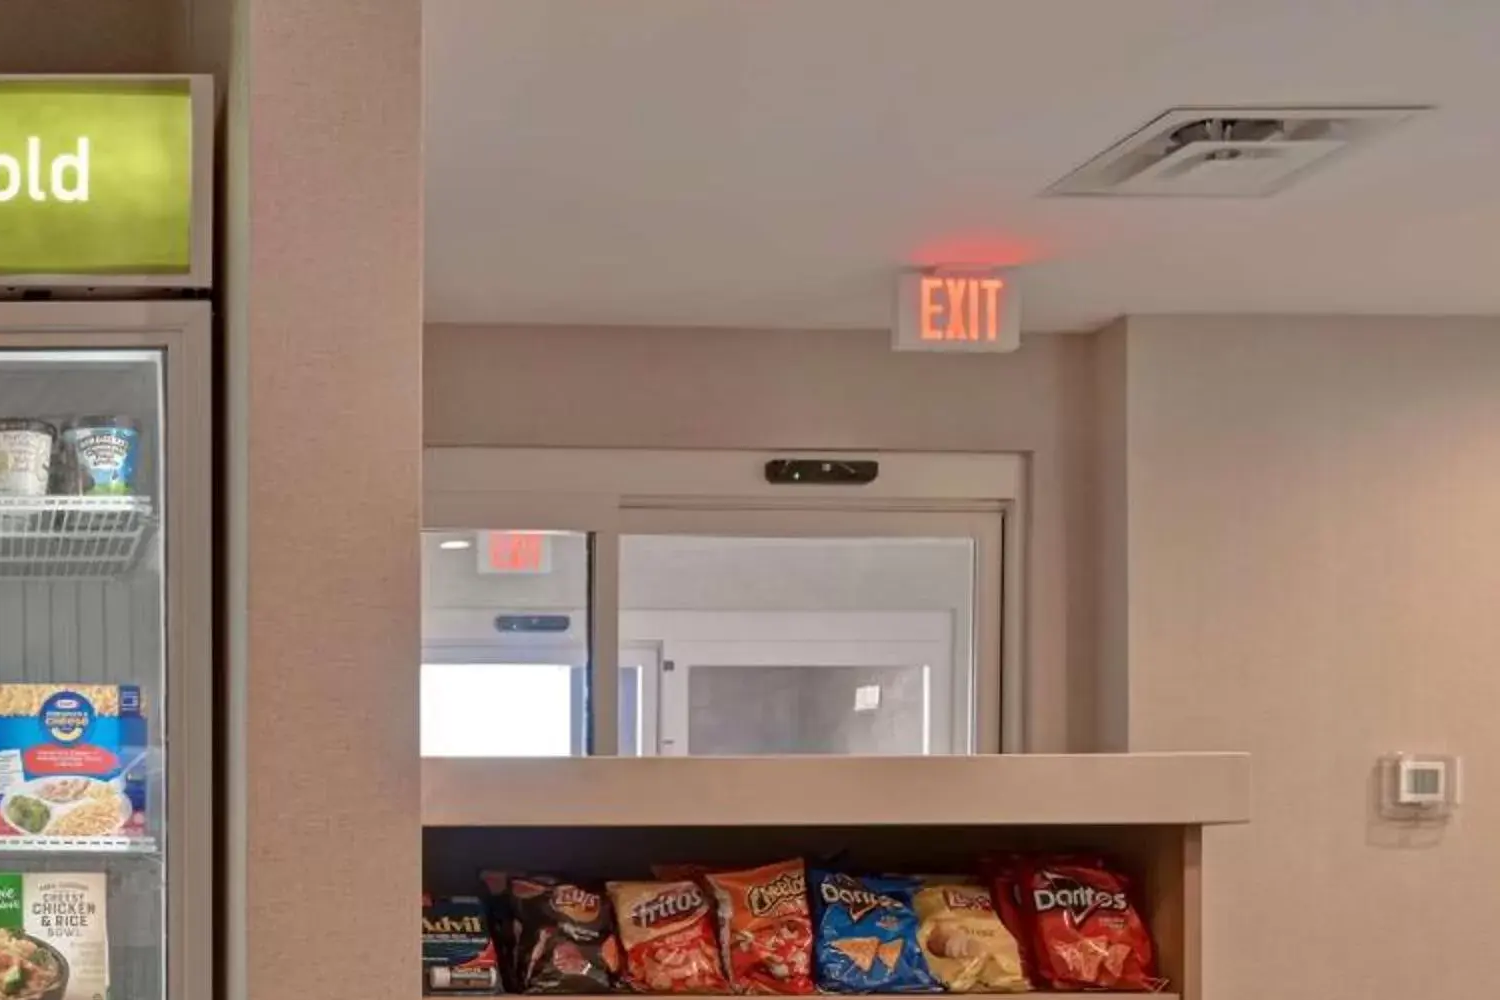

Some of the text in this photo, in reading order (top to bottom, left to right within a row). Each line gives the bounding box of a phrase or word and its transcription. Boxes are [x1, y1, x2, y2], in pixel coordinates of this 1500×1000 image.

[920, 278, 1003, 341] EXIT
[1033, 885, 1127, 912] Doritos
[32, 904, 95, 915] CHICKEN
[41, 916, 88, 927] & RICE
